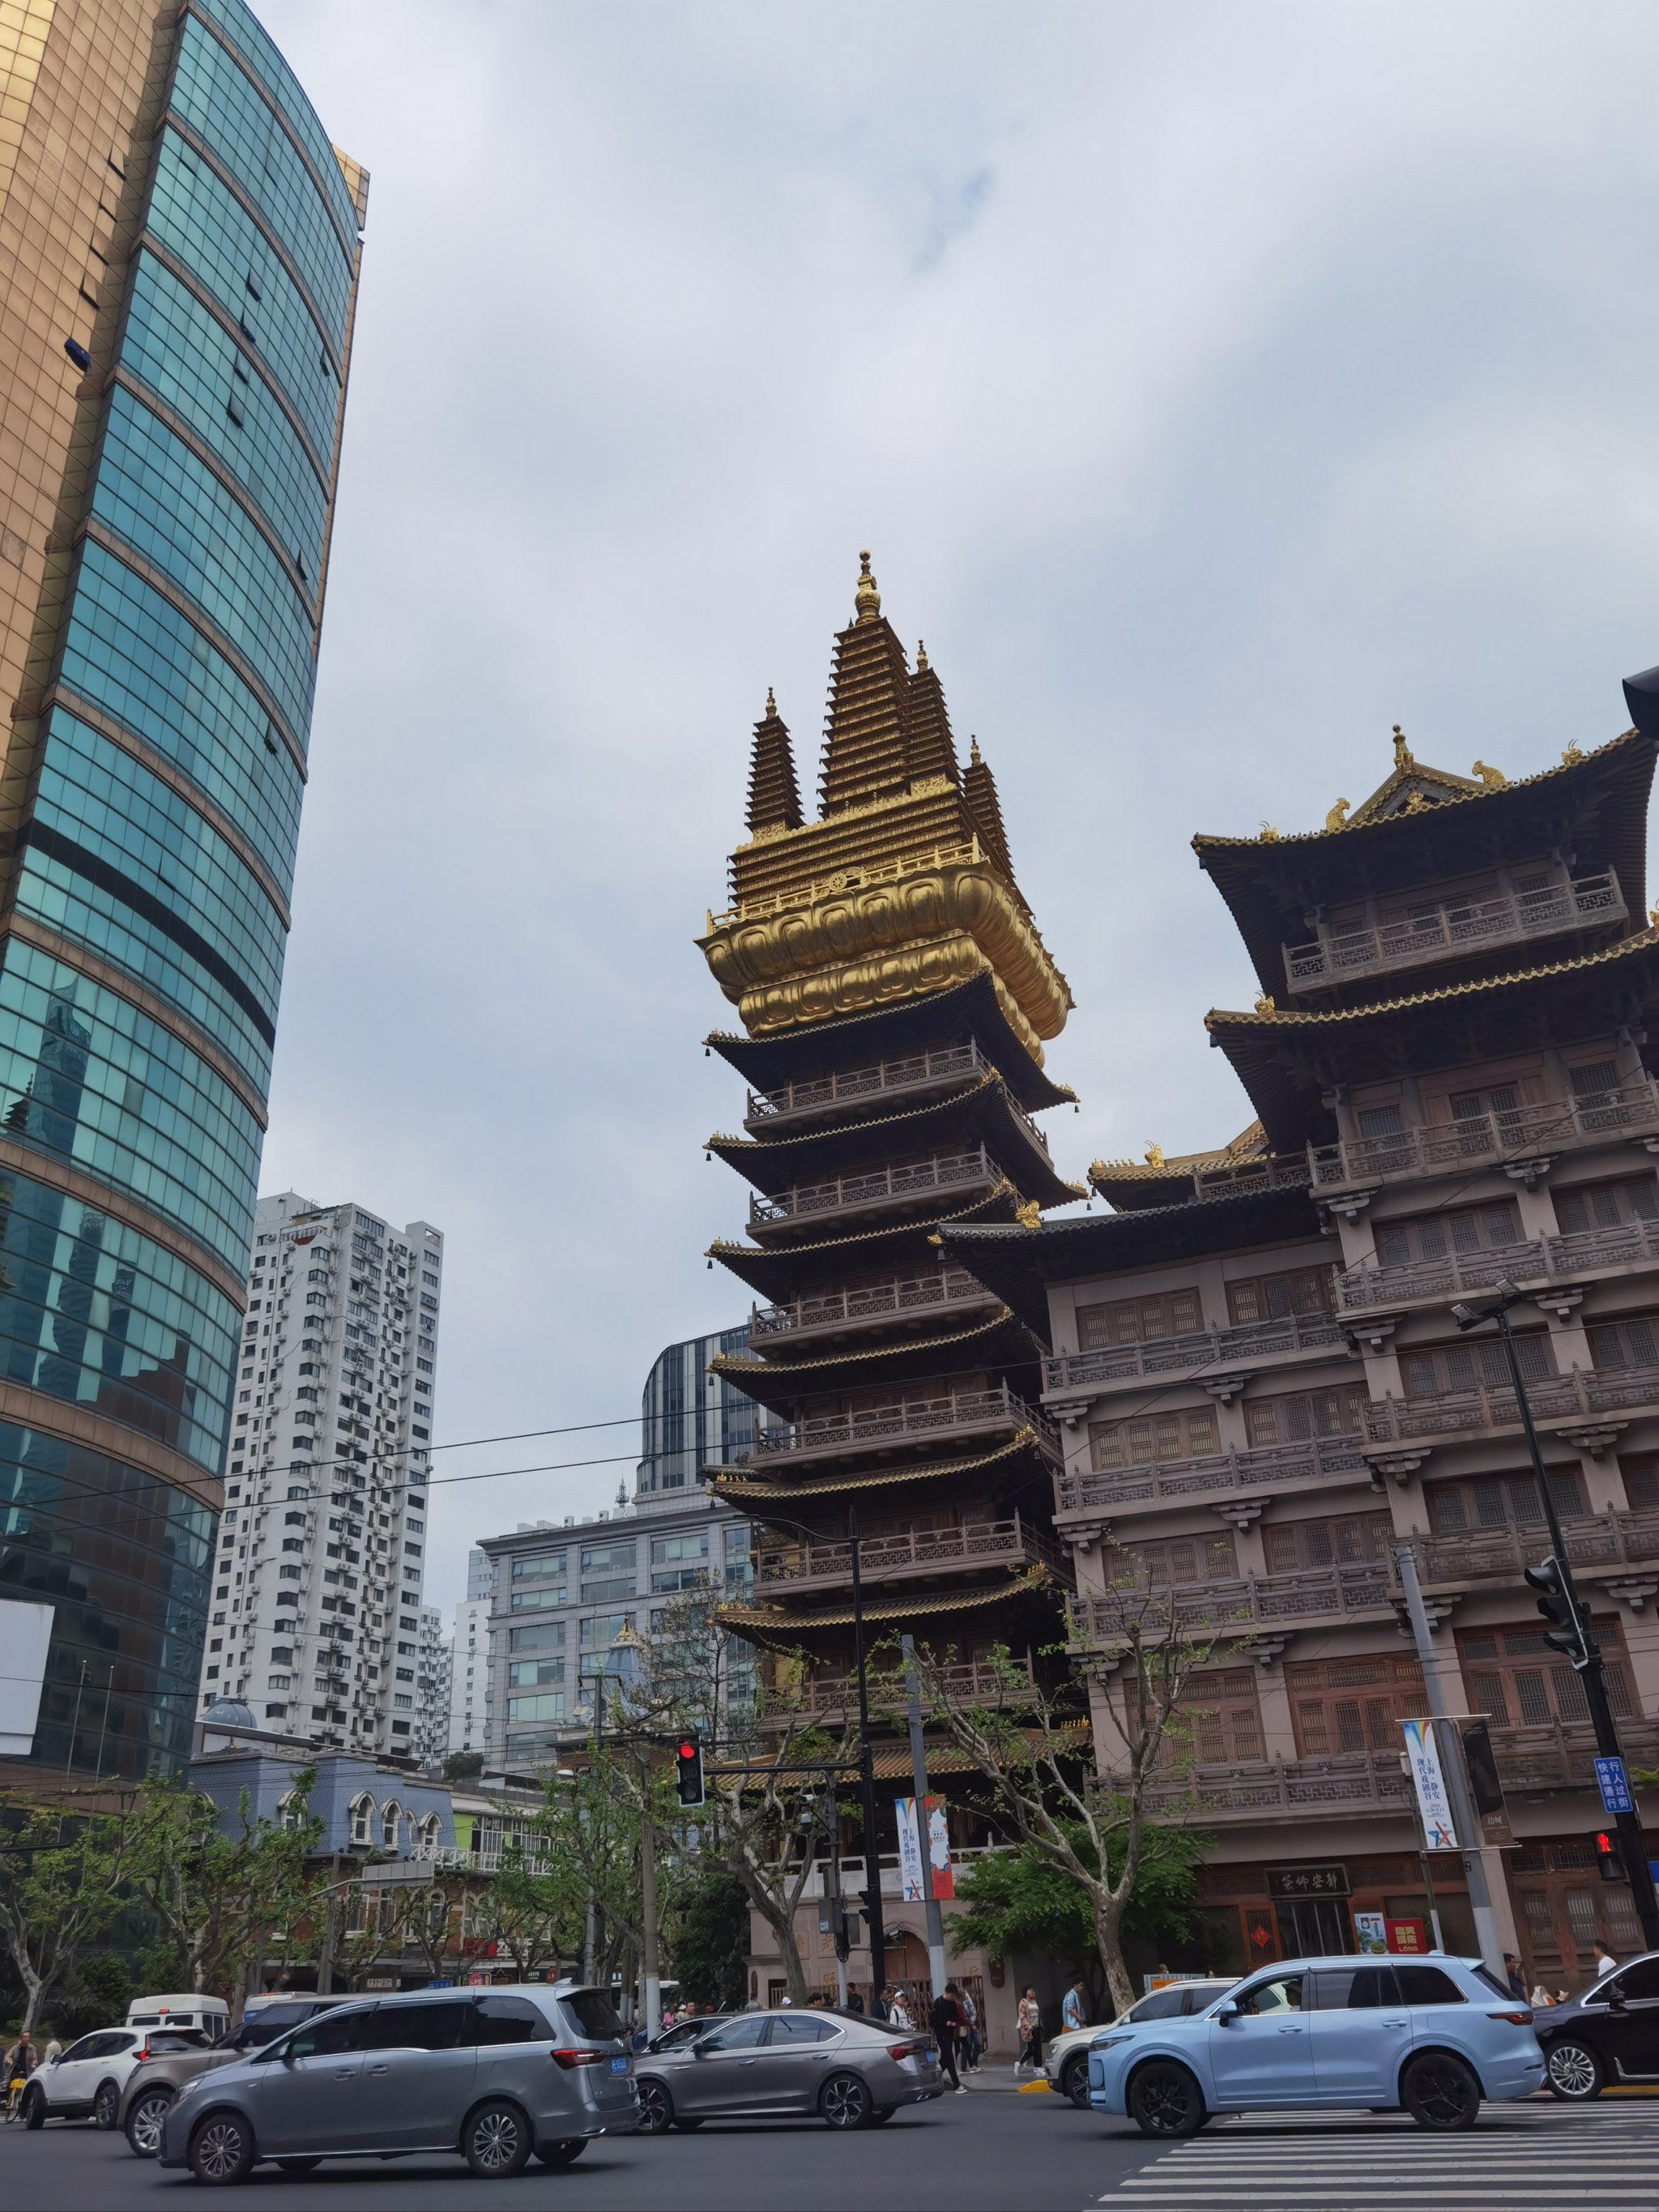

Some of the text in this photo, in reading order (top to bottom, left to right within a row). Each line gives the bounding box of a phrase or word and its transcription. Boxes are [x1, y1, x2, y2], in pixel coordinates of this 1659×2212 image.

[1597, 1762, 1617, 1809] 快速通行
[1610, 1762, 1628, 1807] 行人过街
